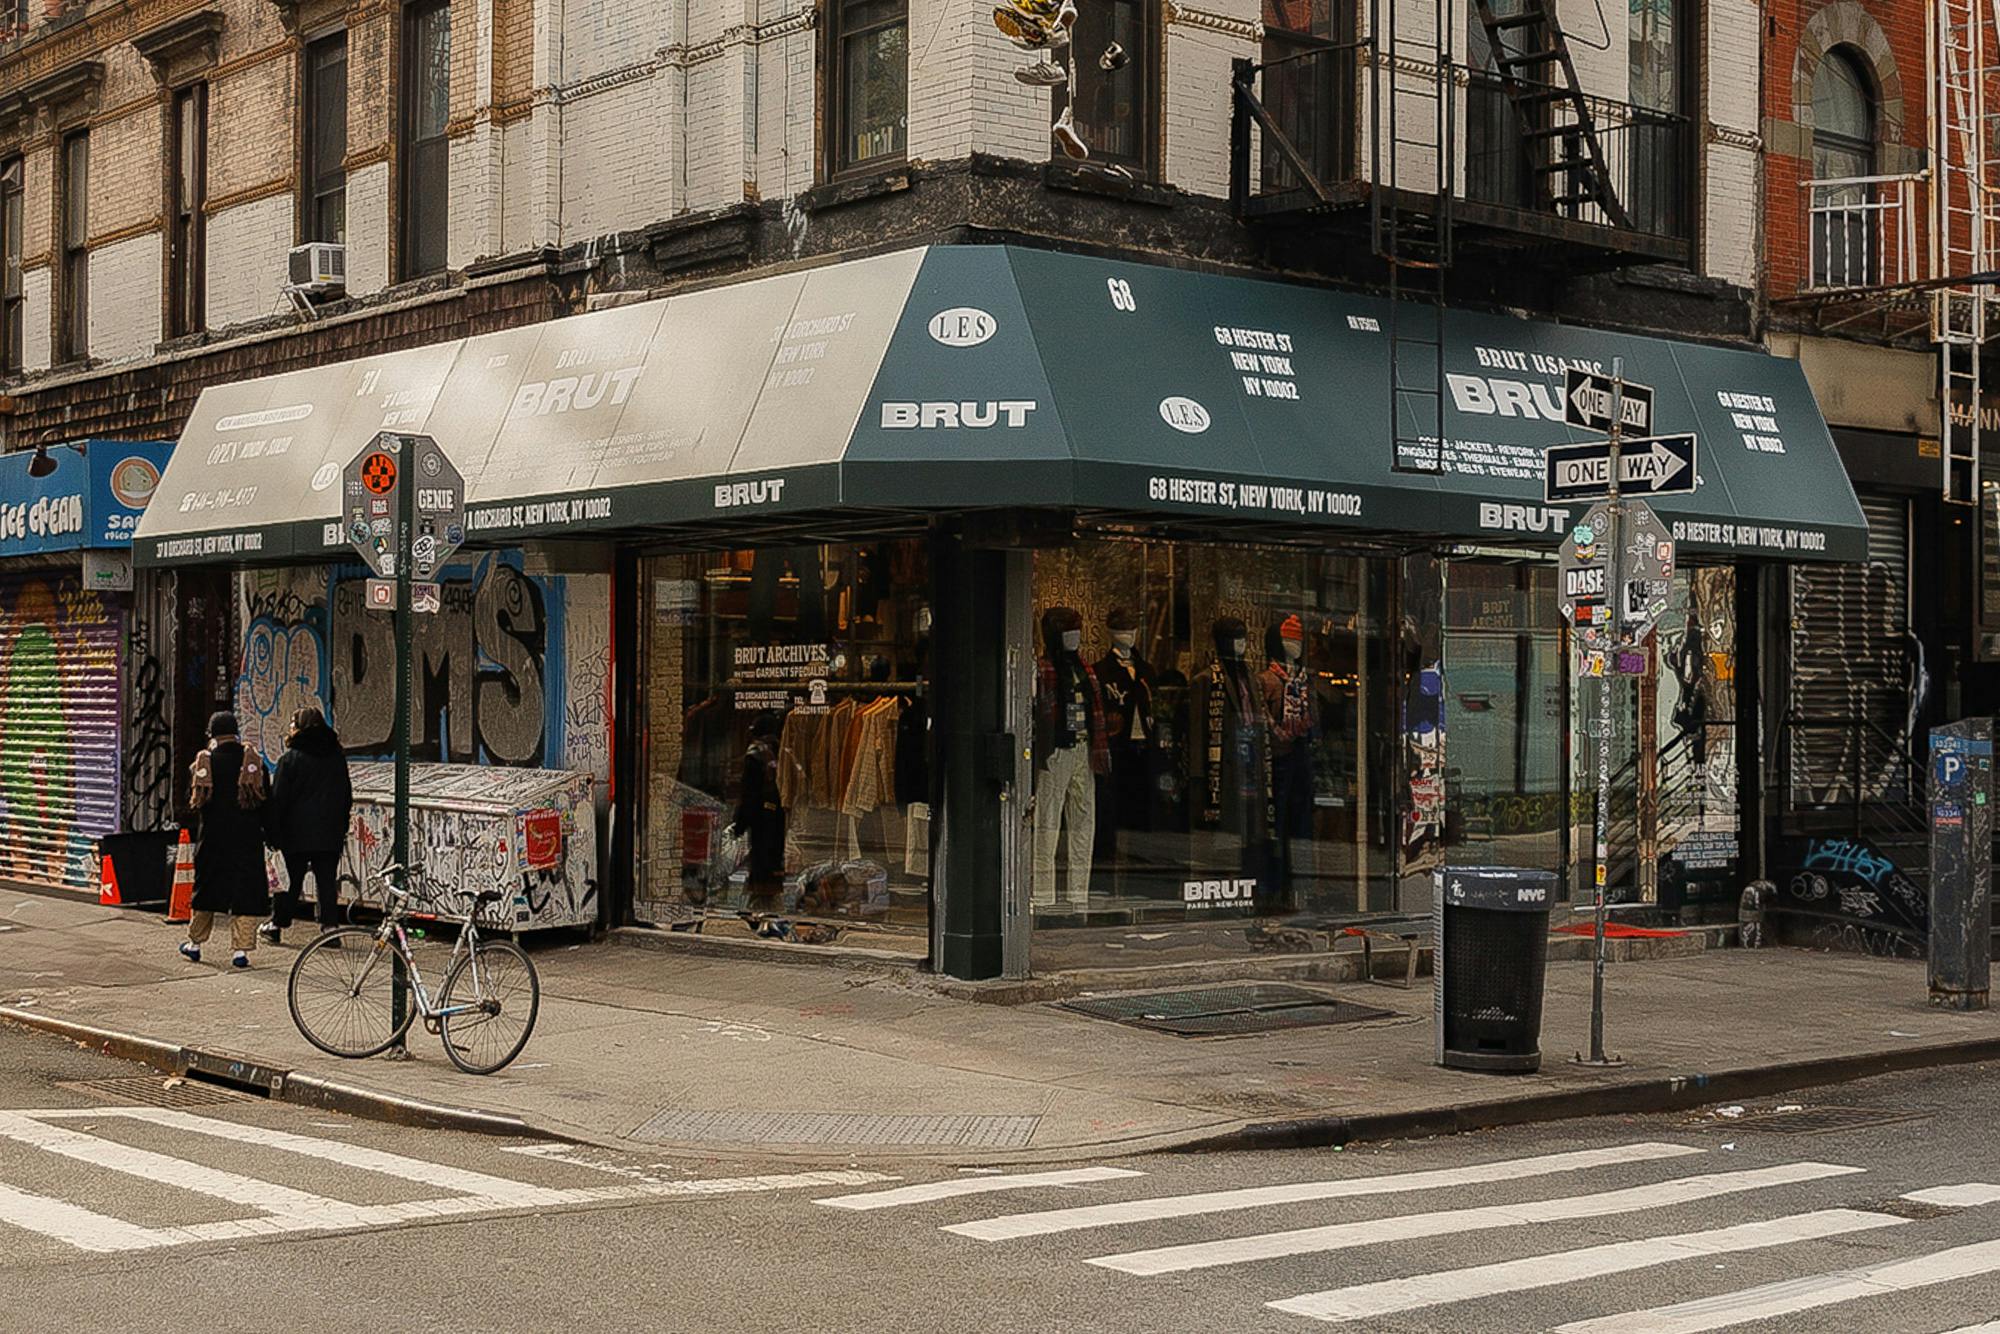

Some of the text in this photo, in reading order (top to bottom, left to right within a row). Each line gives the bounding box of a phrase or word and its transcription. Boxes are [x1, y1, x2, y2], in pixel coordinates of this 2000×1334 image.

[1107, 277, 1136, 312] 68
[1213, 326, 1294, 352] 68 HESTER ST
[1230, 351, 1295, 376] NEW YORK
[1475, 346, 1528, 372] BRUT
[1531, 352, 1567, 376] USA
[508, 366, 645, 419] BRUT
[1243, 376, 1300, 400] NY 10002
[1445, 373, 1567, 421] BRU
[881, 401, 1036, 427] BRUT
[1579, 389, 1604, 414] ONE
[1730, 392, 1765, 412] HESTER
[1762, 396, 1776, 413] ST
[1731, 412, 1780, 433] NEW YORK
[206, 441, 238, 465] OPEN
[1454, 440, 1494, 453] JACKETS
[1498, 444, 1536, 458] REWORK
[1742, 433, 1759, 450] NY
[1458, 463, 1484, 475] BELTS
[1489, 466, 1532, 479] EYEWEAR
[1462, 452, 1508, 466] THERMALS
[1568, 460, 1608, 483] ONE
[1627, 454, 1672, 478] WAY
[418, 489, 454, 509] GENIE
[714, 479, 785, 507] BRUT
[1150, 476, 1361, 515] 68 HESTER ST, NEW YORK, NY 10002
[474, 506, 511, 530] ORCHARD
[512, 505, 525, 528] ST,
[525, 503, 545, 525] NEW
[545, 501, 570, 524] YORK,
[571, 499, 584, 520] NY
[585, 497, 611, 518] 10002
[1480, 502, 1570, 534] BRUT
[1672, 521, 1826, 551] 68 HESTER ST, NEW YORK, NY 10002
[734, 644, 830, 665] BRUT ARCHIVES.
[755, 666, 790, 679] GARMENT
[789, 665, 829, 678] SPECIALIST
[1945, 757, 1960, 782] P
[1184, 878, 1257, 901] BRUT
[1517, 888, 1546, 902] NYC
[1186, 901, 1210, 910] PARIS
